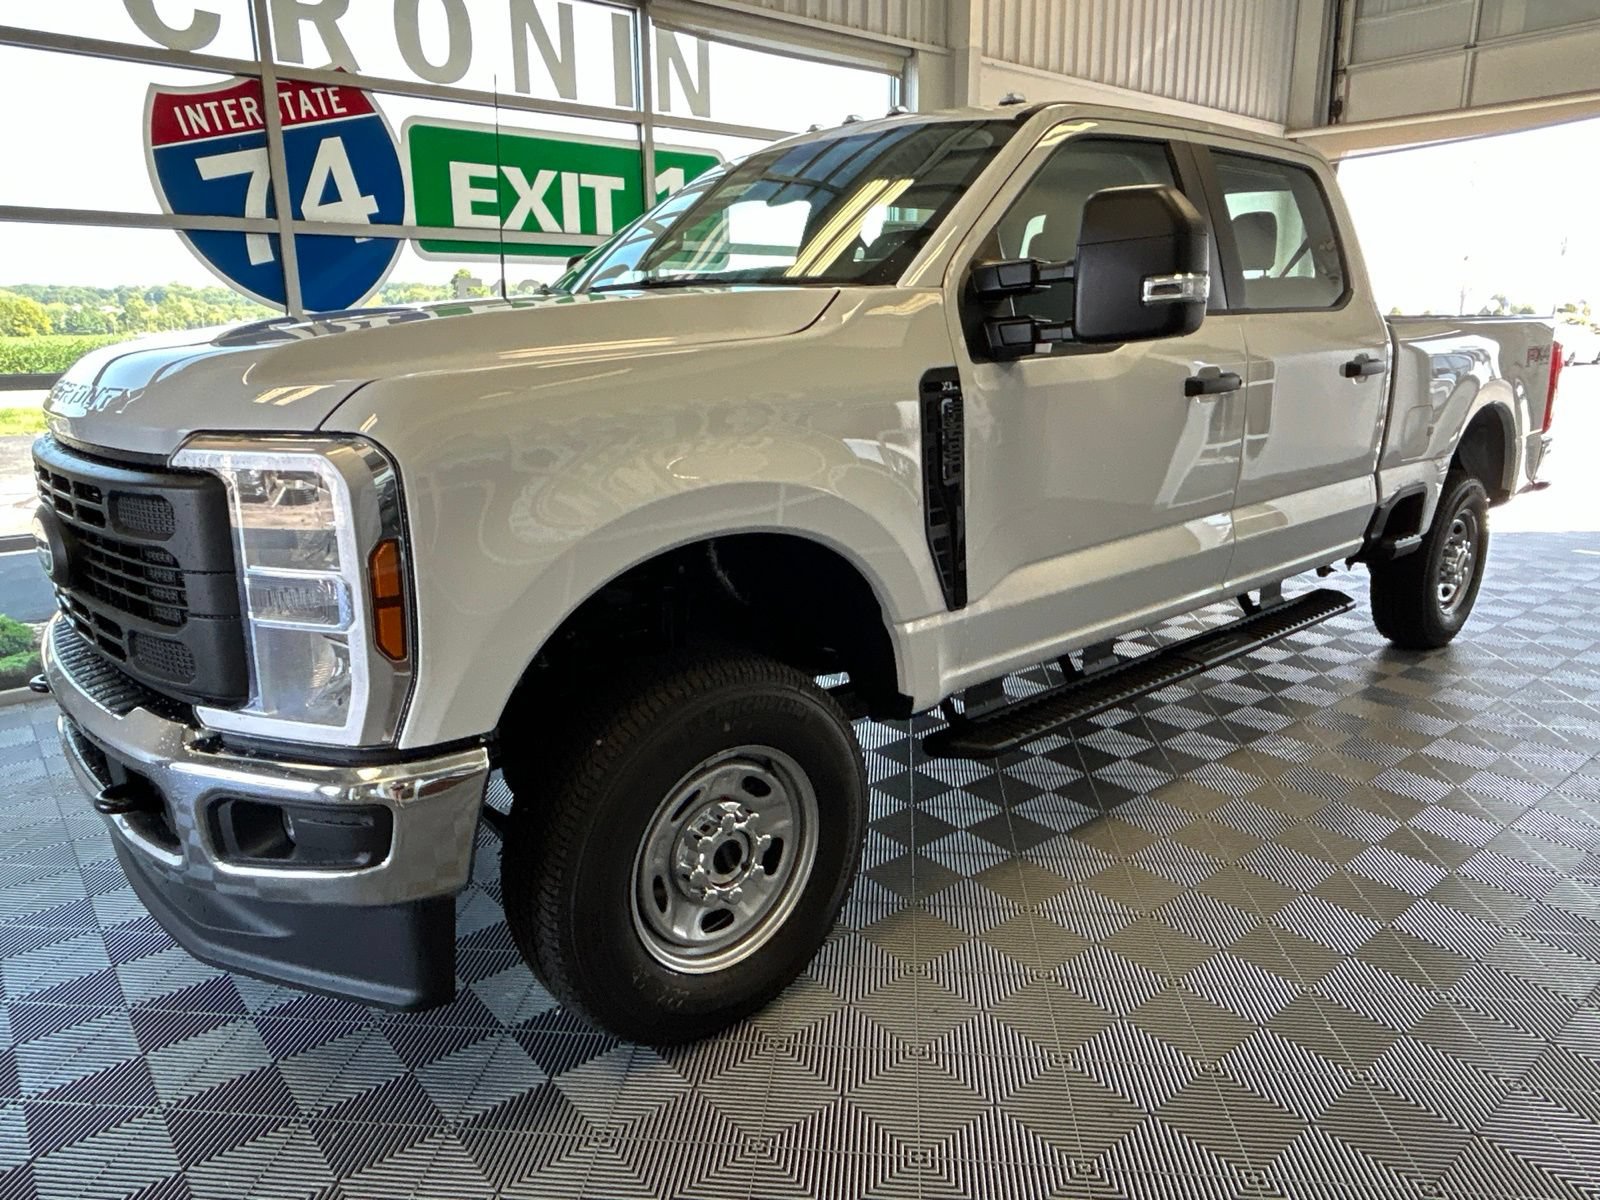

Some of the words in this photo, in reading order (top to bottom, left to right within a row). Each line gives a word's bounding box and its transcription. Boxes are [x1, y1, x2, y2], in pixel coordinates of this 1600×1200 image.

[173, 86, 347, 137] INTERTATE
[195, 135, 379, 266] 74
[449, 161, 625, 236] EXIT
